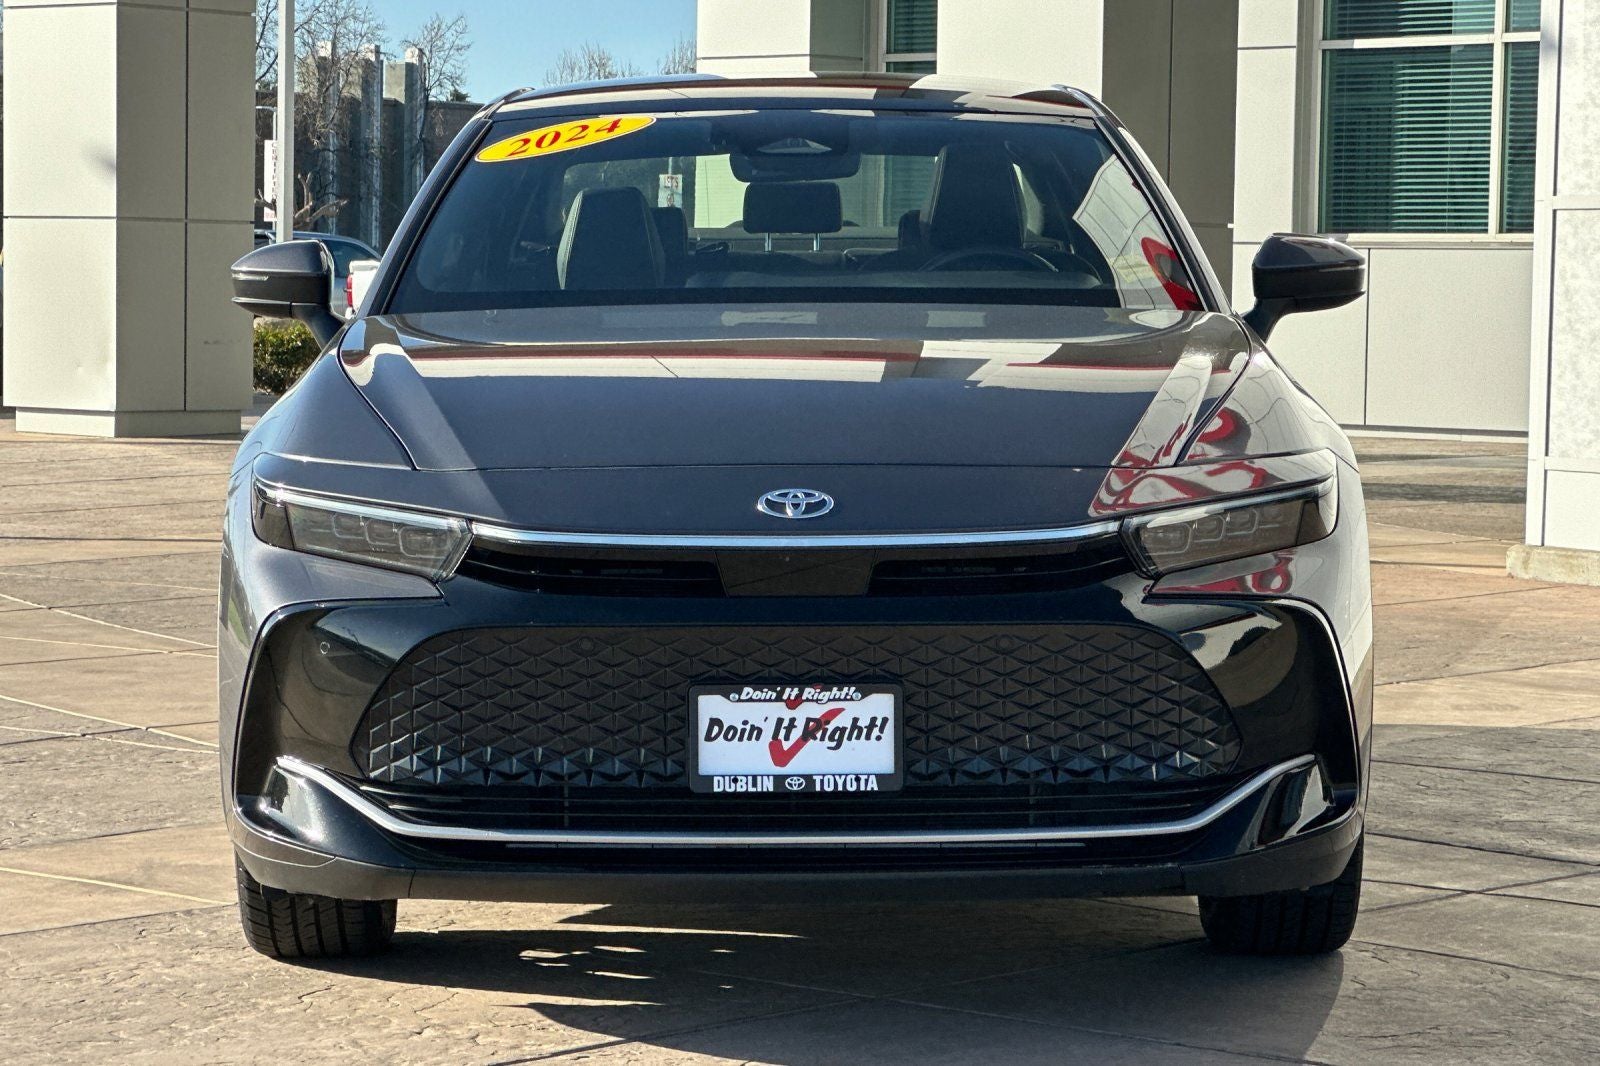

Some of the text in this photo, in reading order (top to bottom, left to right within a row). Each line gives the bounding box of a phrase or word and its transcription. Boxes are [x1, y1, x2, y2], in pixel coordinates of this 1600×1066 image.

[506, 118, 623, 157] 2024
[740, 686, 857, 705] Doin' It Right!
[704, 716, 889, 750] Doin' It Right!
[713, 774, 879, 792] DUBLIN TOYOTA
